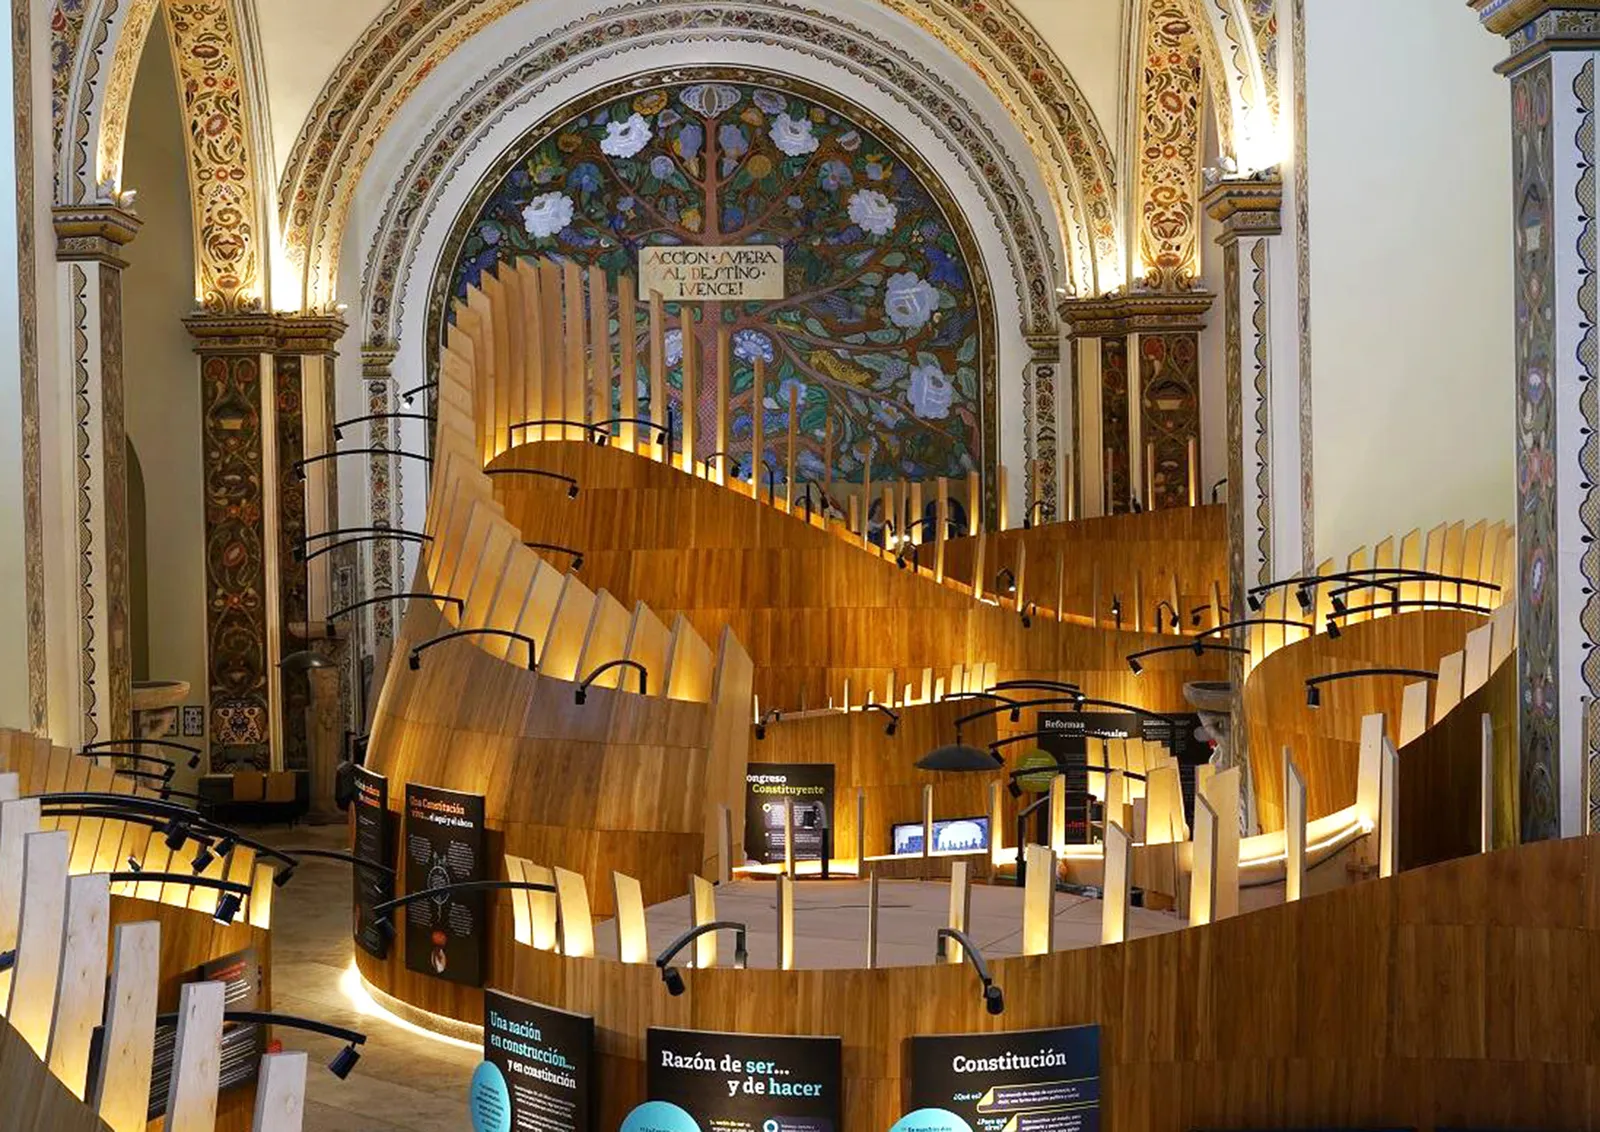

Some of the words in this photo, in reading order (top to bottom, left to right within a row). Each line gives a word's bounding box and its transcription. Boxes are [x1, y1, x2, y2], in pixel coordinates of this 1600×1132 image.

[663, 267, 685, 281] AL
[1045, 720, 1085, 729] Reformas
[746, 775, 787, 784] ongreso
[752, 784, 825, 796] Constituyente
[490, 1011, 508, 1030] Una
[508, 1021, 542, 1042] nación
[490, 1033, 501, 1047] en
[661, 1051, 716, 1071] Razón
[720, 1054, 741, 1072] de
[745, 1060, 790, 1075] ser...
[952, 1049, 1067, 1073] Constitución
[507, 1060, 513, 1072] y
[513, 1062, 522, 1073] en
[523, 1067, 577, 1089] constitución
[727, 1080, 740, 1097] y
[742, 1077, 765, 1094] de
[768, 1078, 823, 1096] hacer
